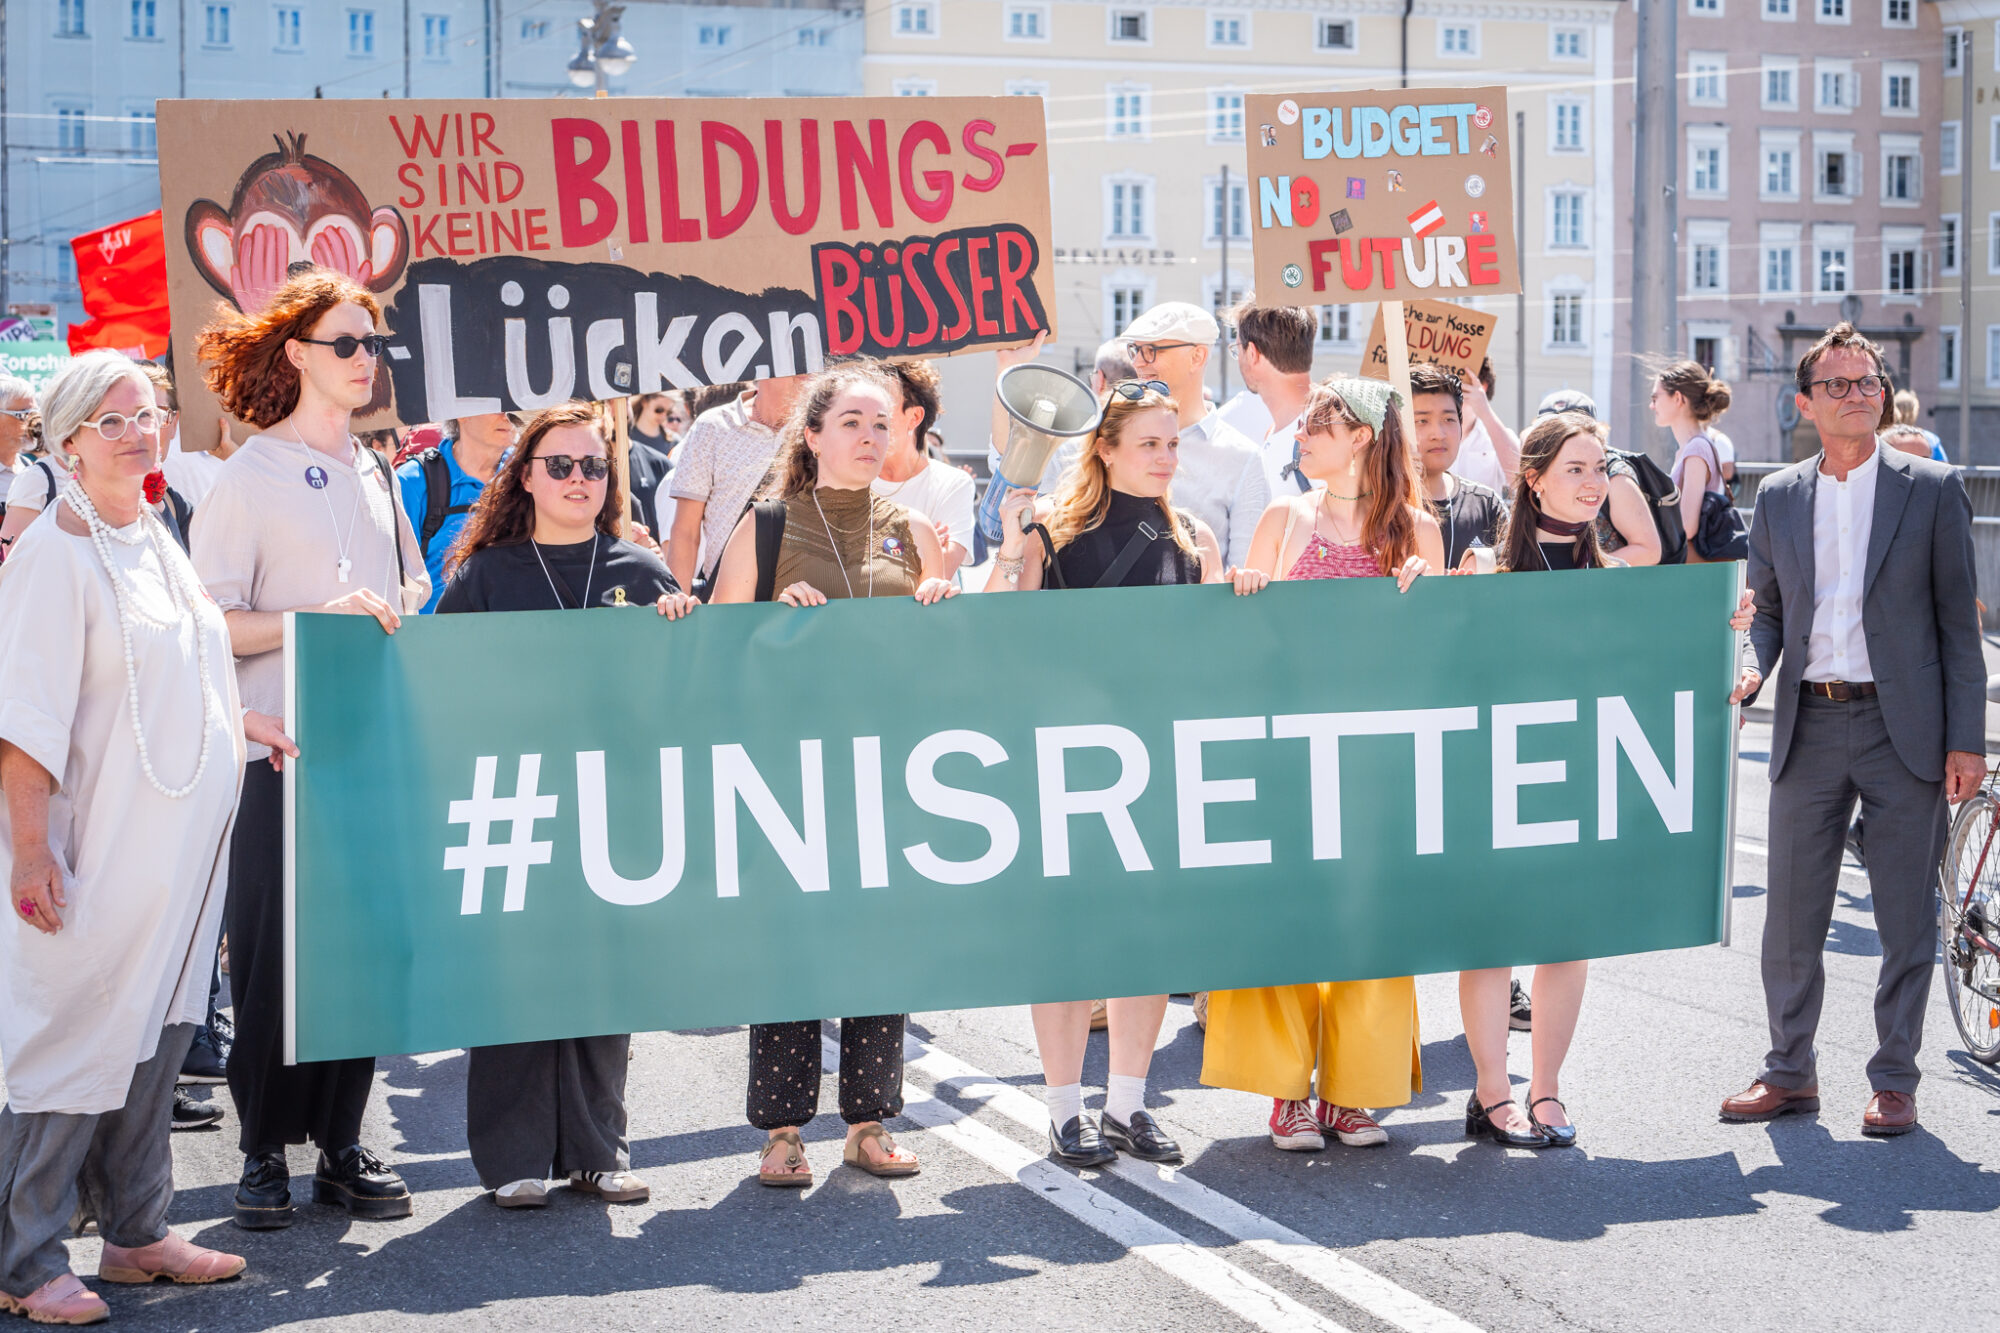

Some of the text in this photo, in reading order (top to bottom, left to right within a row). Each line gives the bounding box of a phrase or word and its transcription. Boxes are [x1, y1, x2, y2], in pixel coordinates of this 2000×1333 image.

[388, 112, 505, 158] WIR
[1301, 102, 1478, 160] BUDGET
[398, 162, 525, 208] SIND
[551, 117, 1039, 248] BILDUNGS-
[1258, 175, 1321, 229] NO
[413, 208, 551, 257] KEINE
[1308, 234, 1501, 292] FUTURE
[1384, 320, 1472, 359] LDUNG
[1446, 314, 1485, 336] Kasse
[443, 690, 1695, 916] #UNISRETTEN
